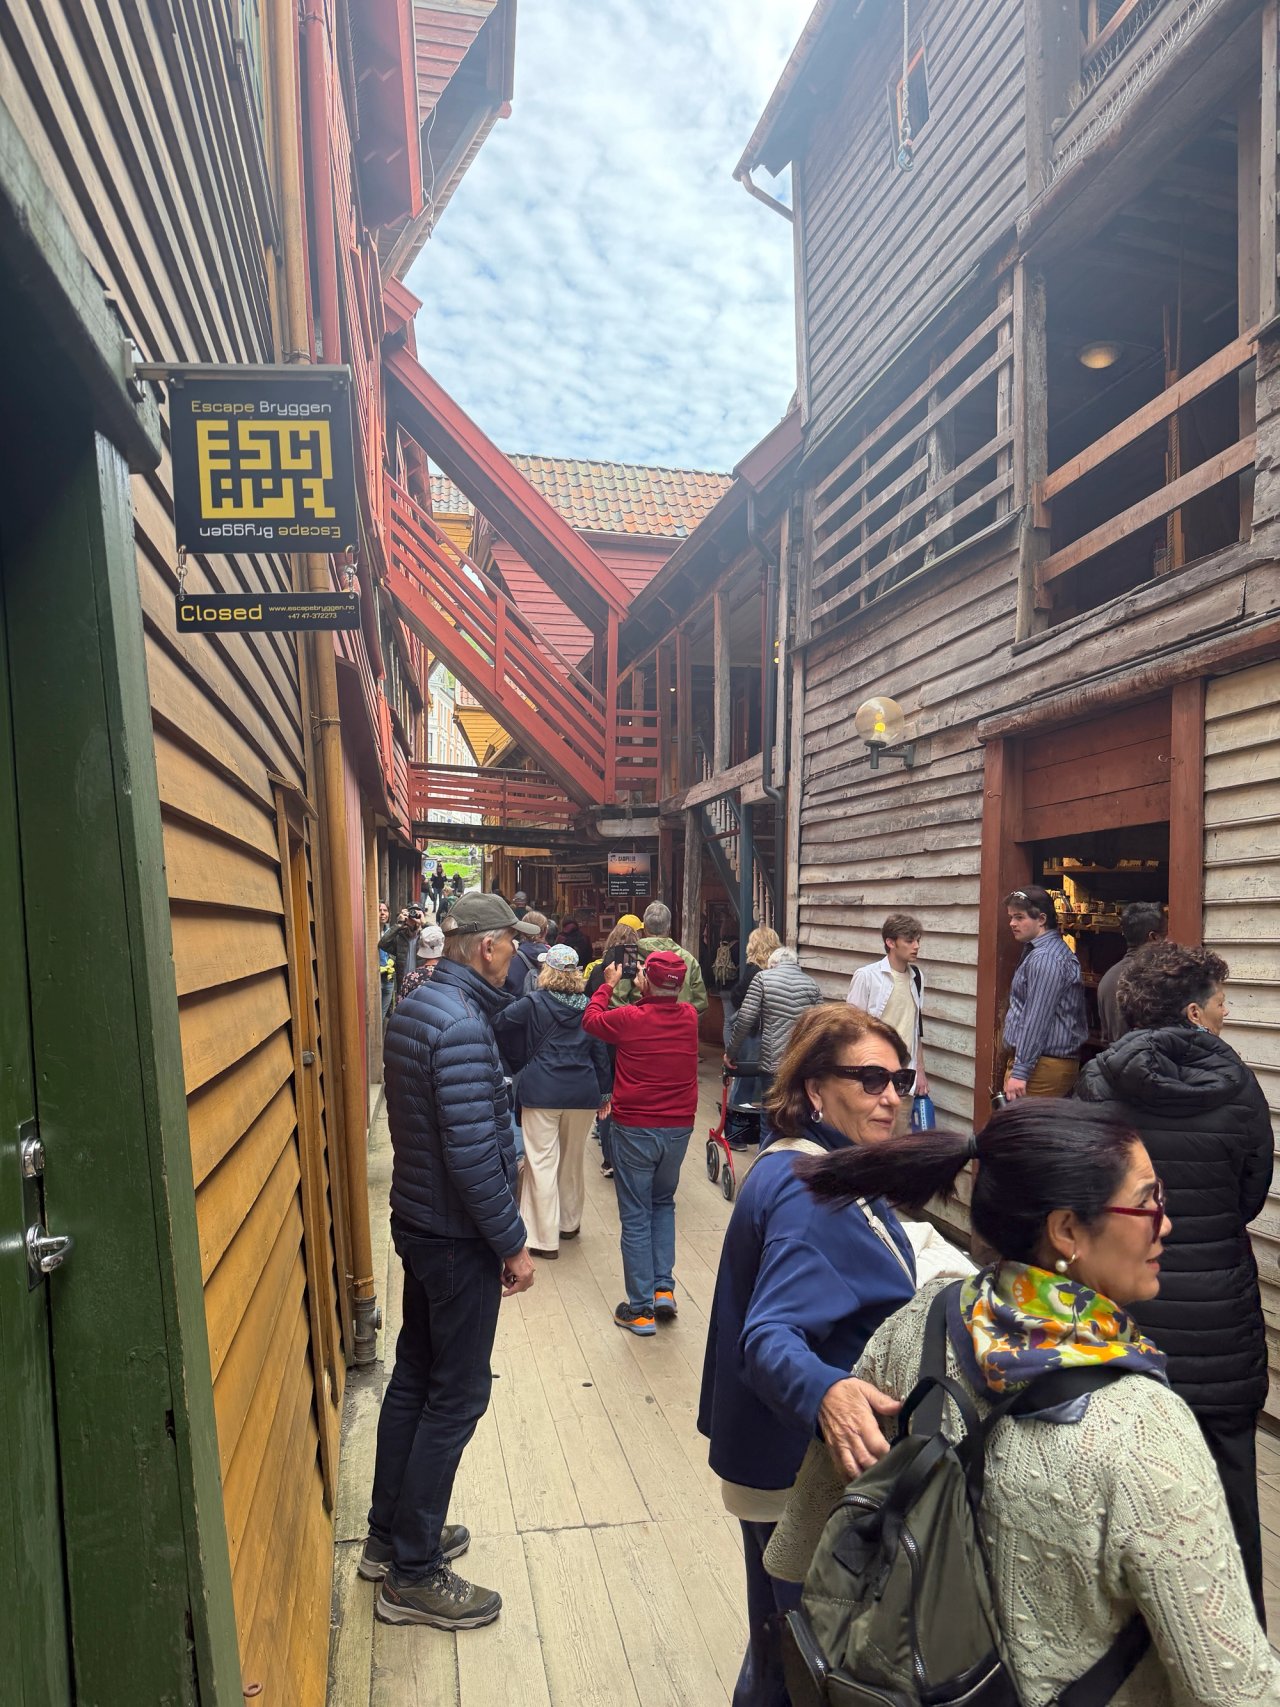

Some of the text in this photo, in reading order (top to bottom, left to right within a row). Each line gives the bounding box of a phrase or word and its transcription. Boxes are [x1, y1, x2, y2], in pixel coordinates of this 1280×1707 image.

[191, 400, 332, 416] Escape Bryggen
[199, 523, 341, 539] Escape Bryggen
[180, 603, 263, 622] Closed
[268, 604, 355, 612] www.escapebryggen.no
